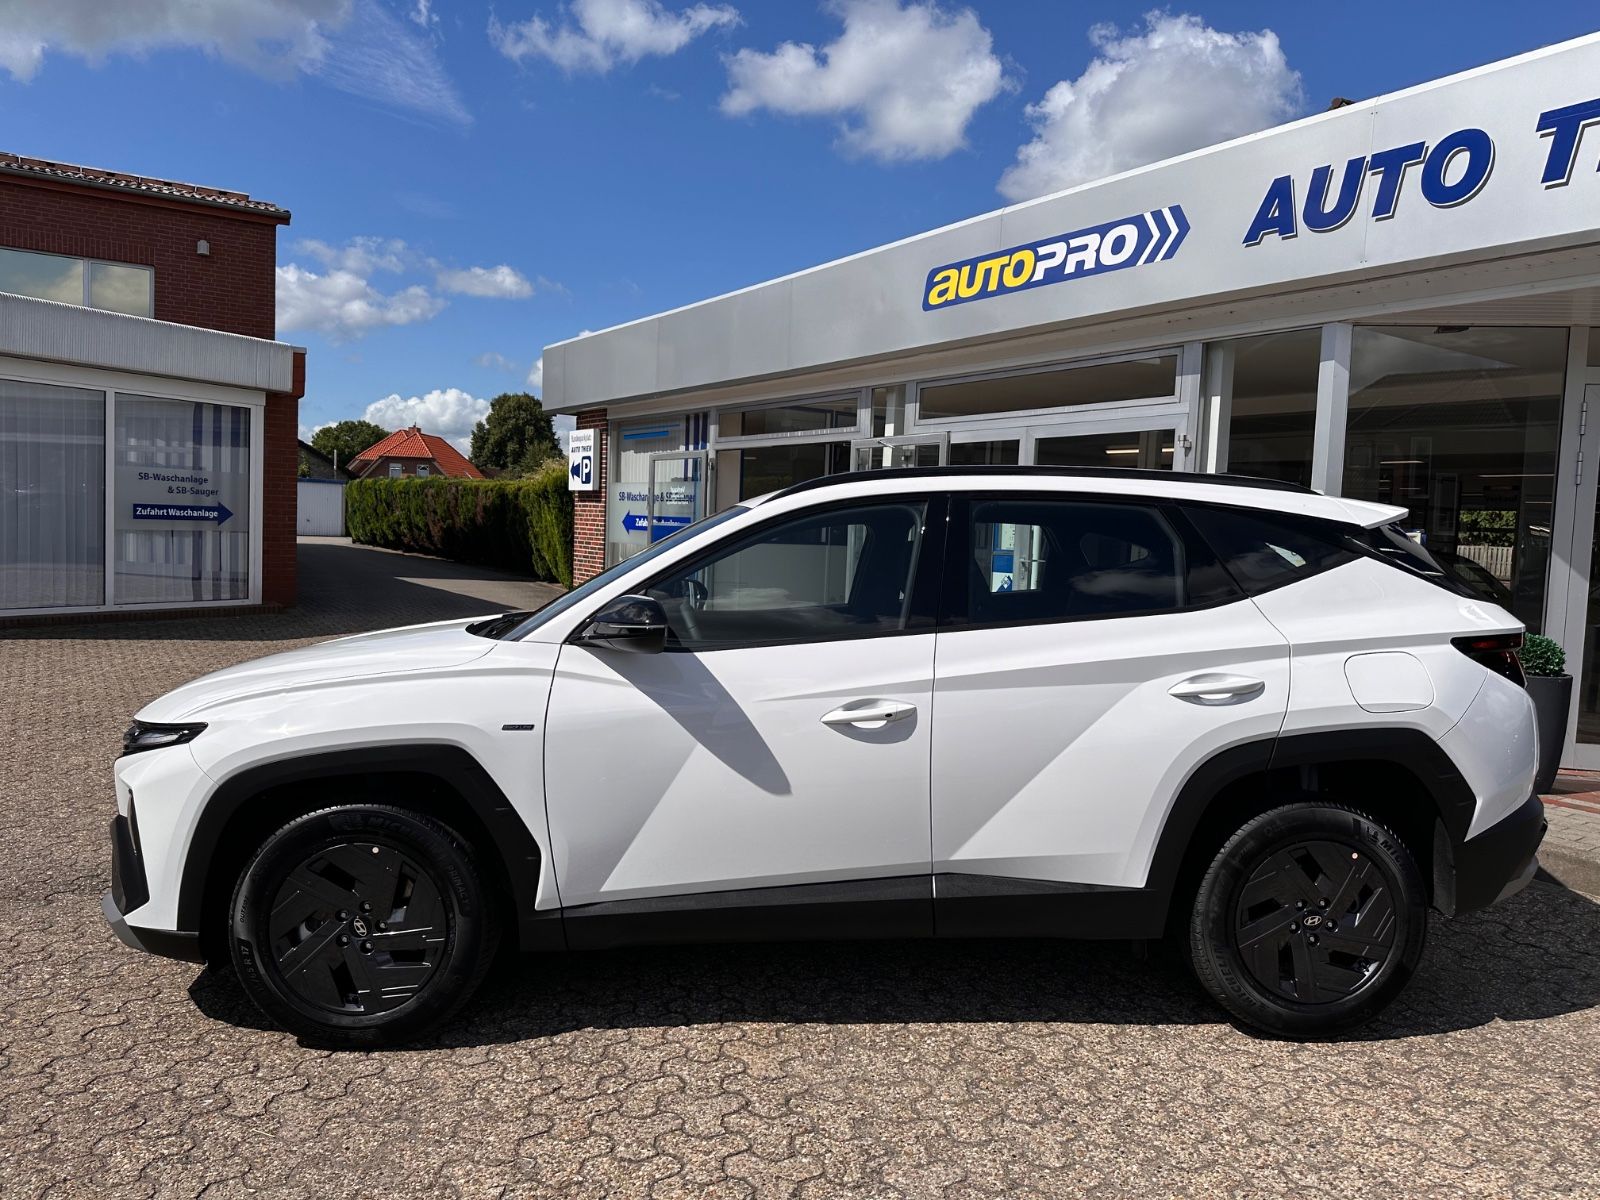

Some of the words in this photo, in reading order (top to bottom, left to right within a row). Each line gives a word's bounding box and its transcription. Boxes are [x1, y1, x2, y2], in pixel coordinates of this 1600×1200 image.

[1242, 128, 1495, 247] AUTO
[1536, 98, 1600, 190] T
[583, 459, 590, 481] P
[138, 472, 209, 485] SB-Waschanlage
[167, 486, 174, 494] &
[176, 486, 219, 497] SB-Sauger
[136, 507, 167, 516] Zufahrt
[168, 508, 218, 519] Waschanlage
